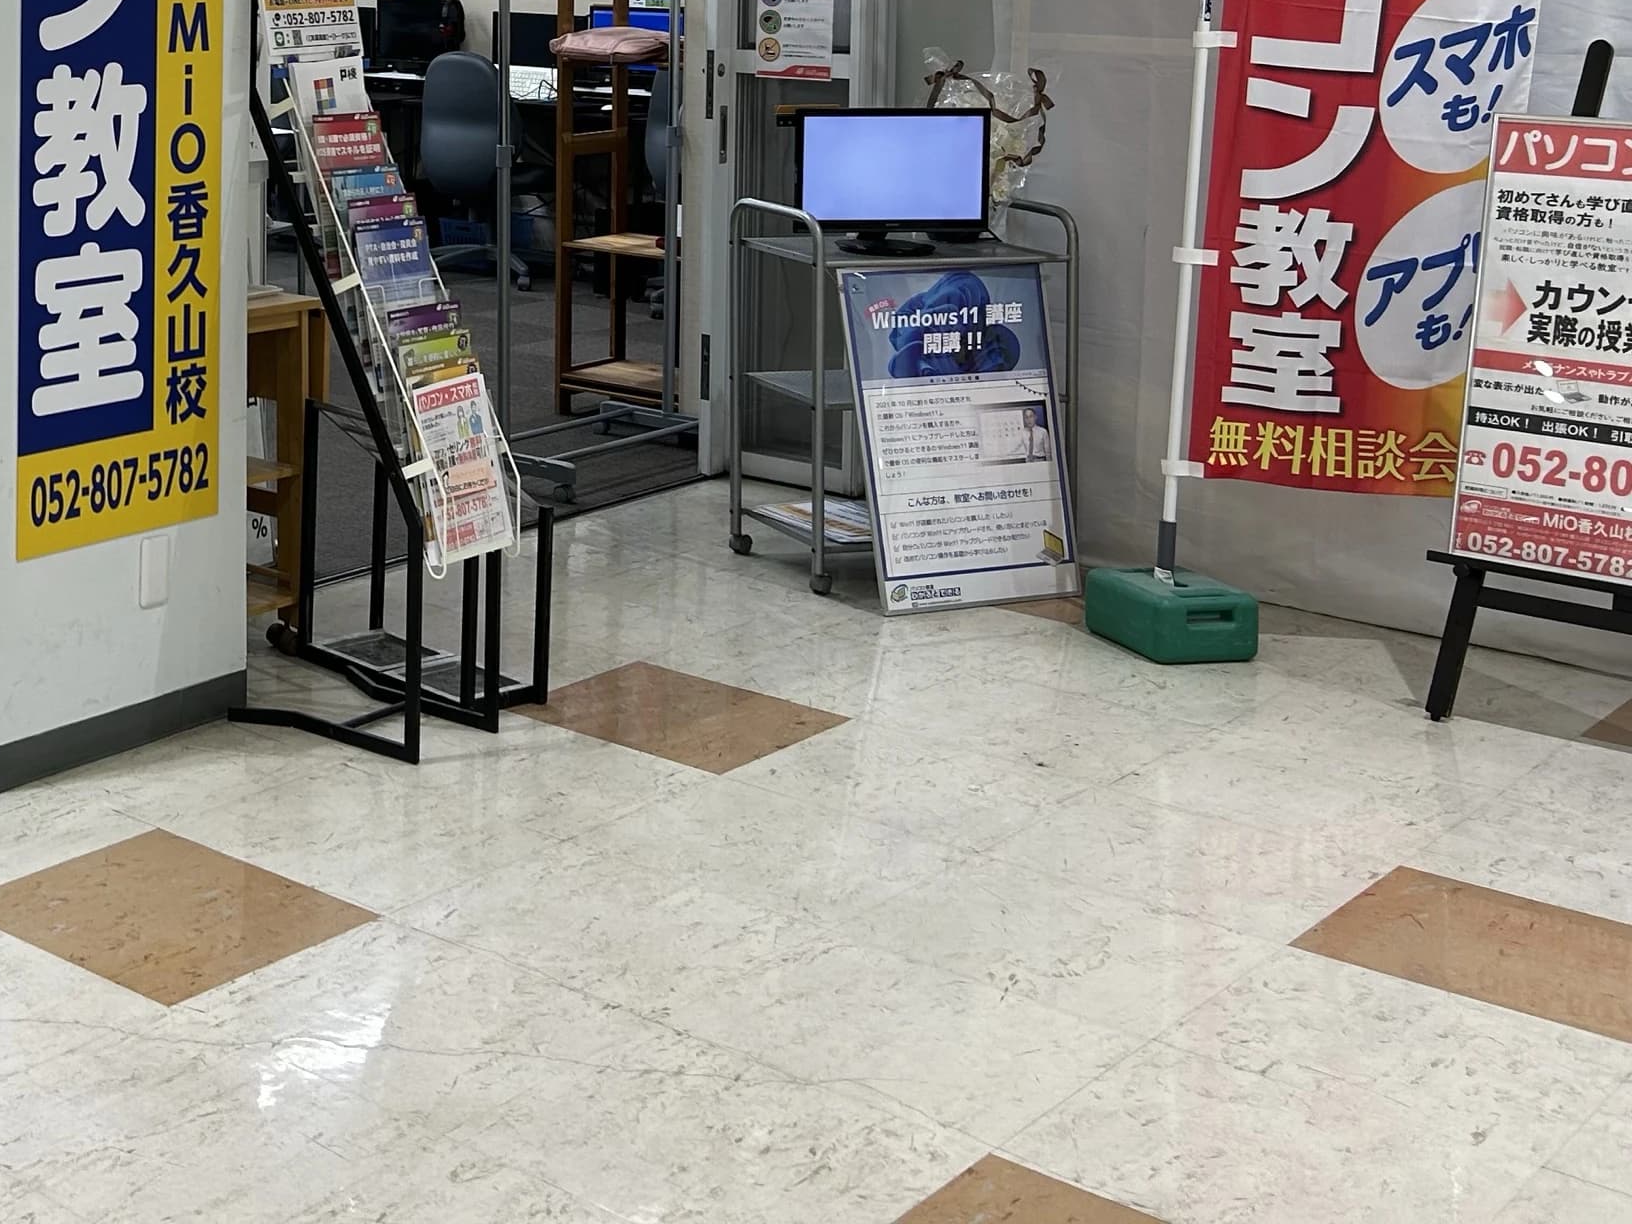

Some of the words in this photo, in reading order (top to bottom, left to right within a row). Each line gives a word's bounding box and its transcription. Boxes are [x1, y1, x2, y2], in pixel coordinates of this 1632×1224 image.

[1386, 4, 1537, 108] スマホ
[165, 1, 210, 426] MiO香久山校
[871, 306, 979, 330] Windows11
[985, 302, 1023, 326] 講座
[1532, 280, 1632, 316] カウン
[1598, 393, 1632, 408] 動作が
[1208, 415, 1457, 483] 無料相談会
[30, 442, 210, 528] 052-807-5782
